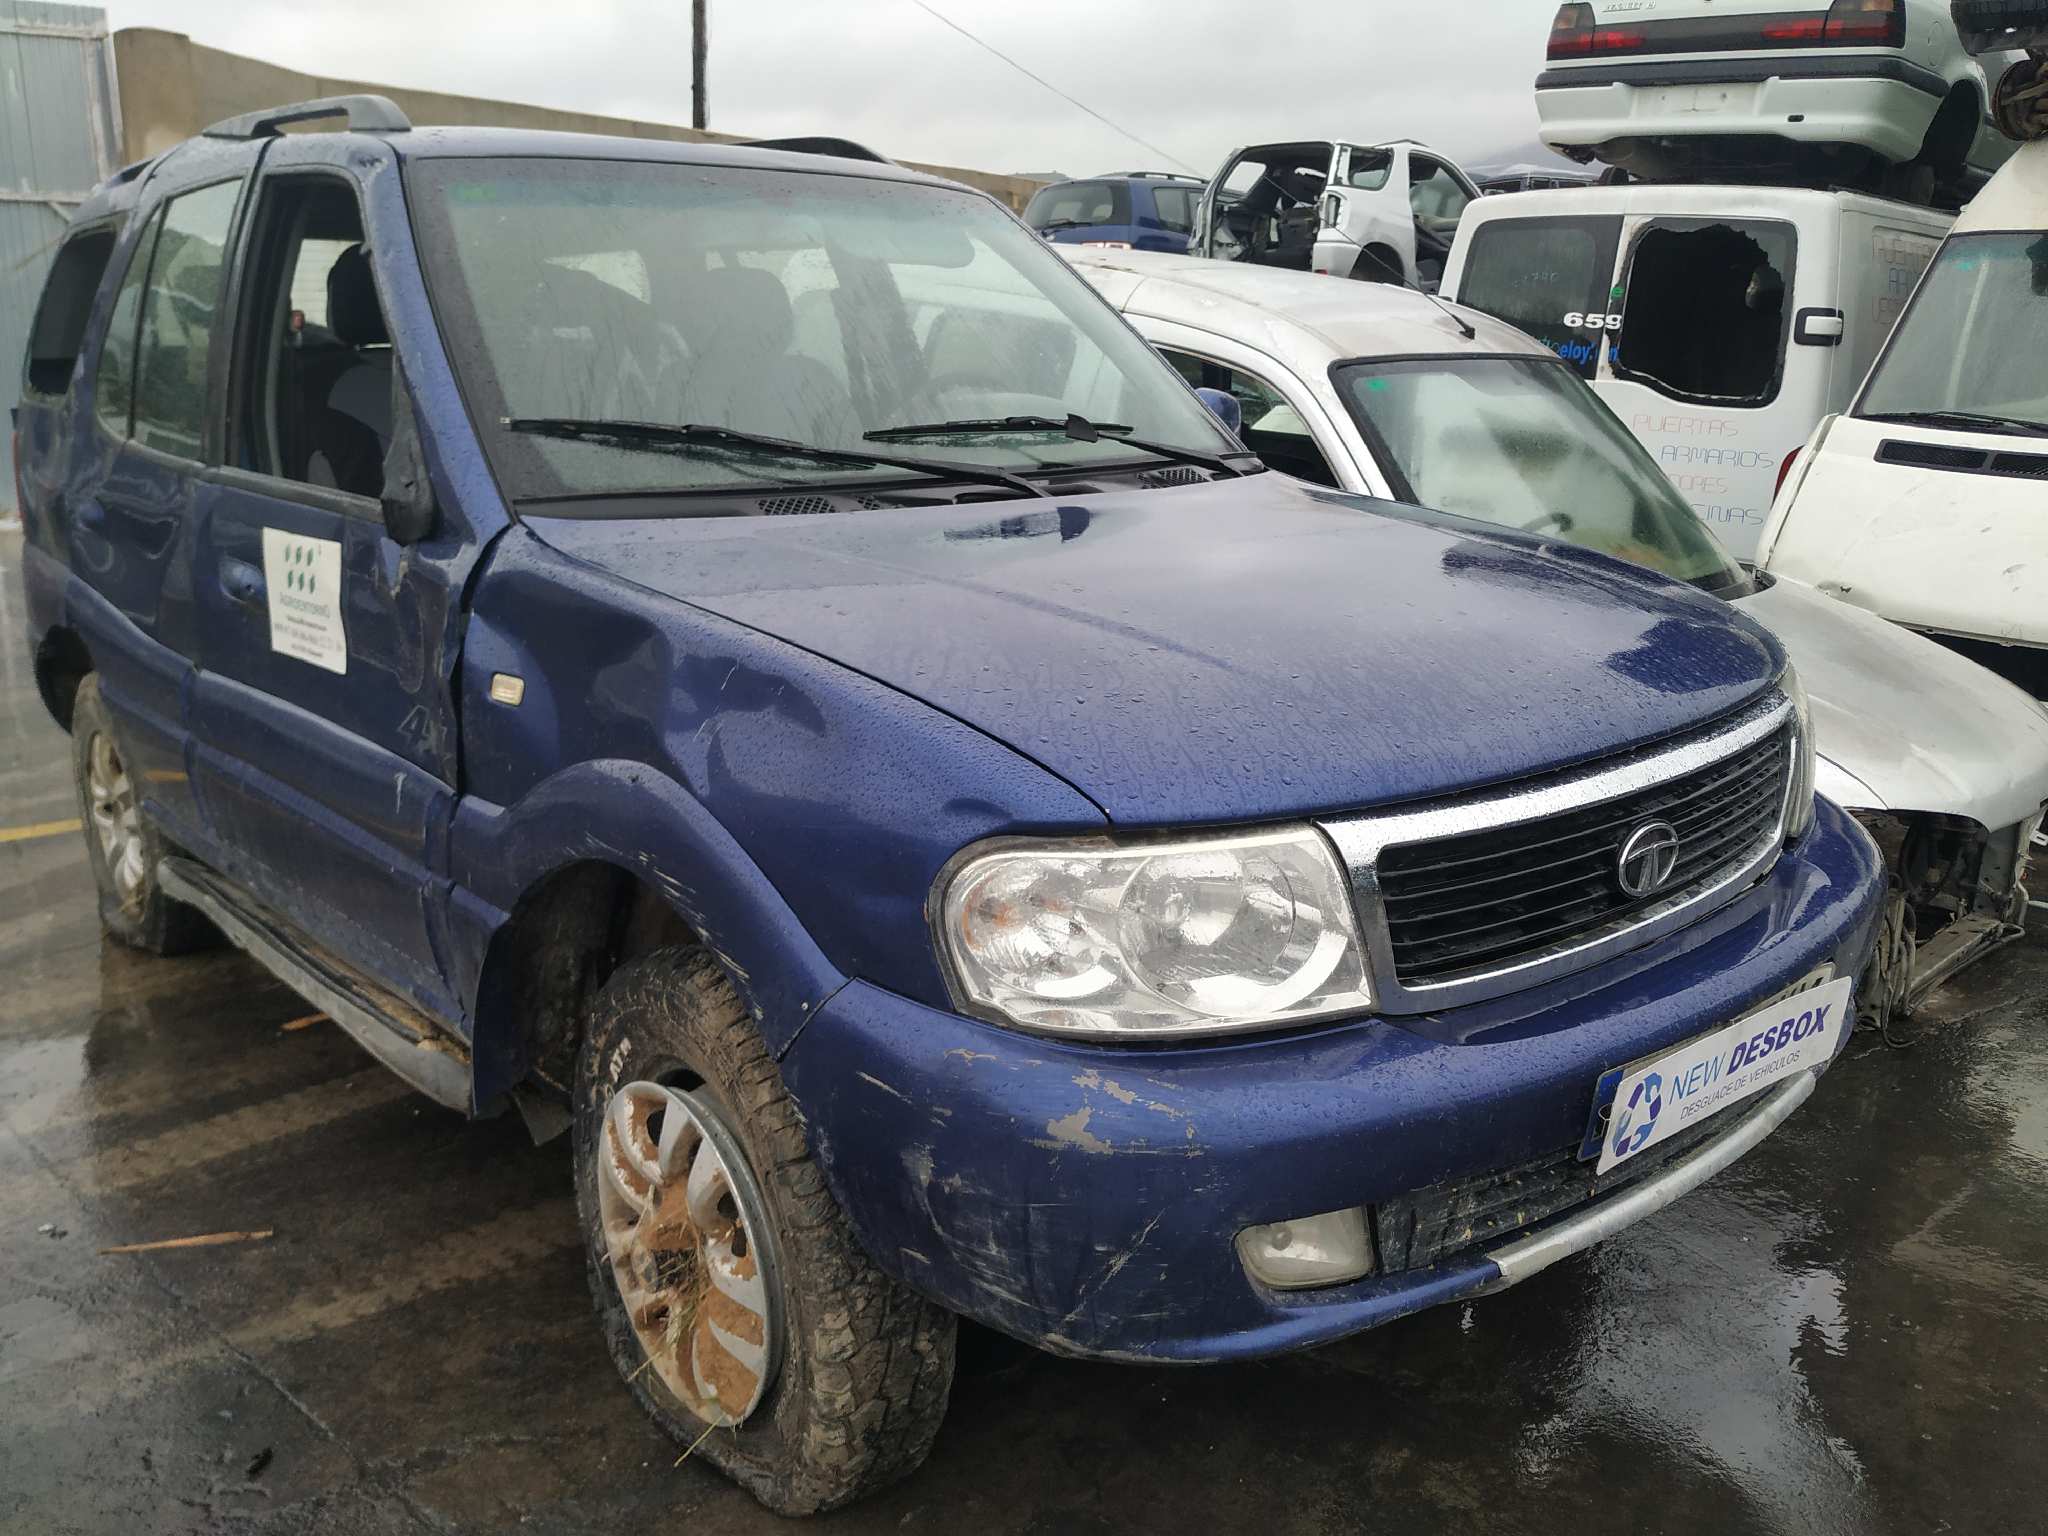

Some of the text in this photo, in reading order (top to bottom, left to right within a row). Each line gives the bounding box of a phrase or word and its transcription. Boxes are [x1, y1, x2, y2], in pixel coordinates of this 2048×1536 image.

[1563, 311, 1623, 330] 659
[1633, 413, 1739, 438] PUERTAS
[1660, 444, 1775, 469] ARMARIOS
[1669, 1002, 1833, 1105] NEW DESBOX
[1680, 1049, 1801, 1121] DESGUACE DE VEHICULOS
